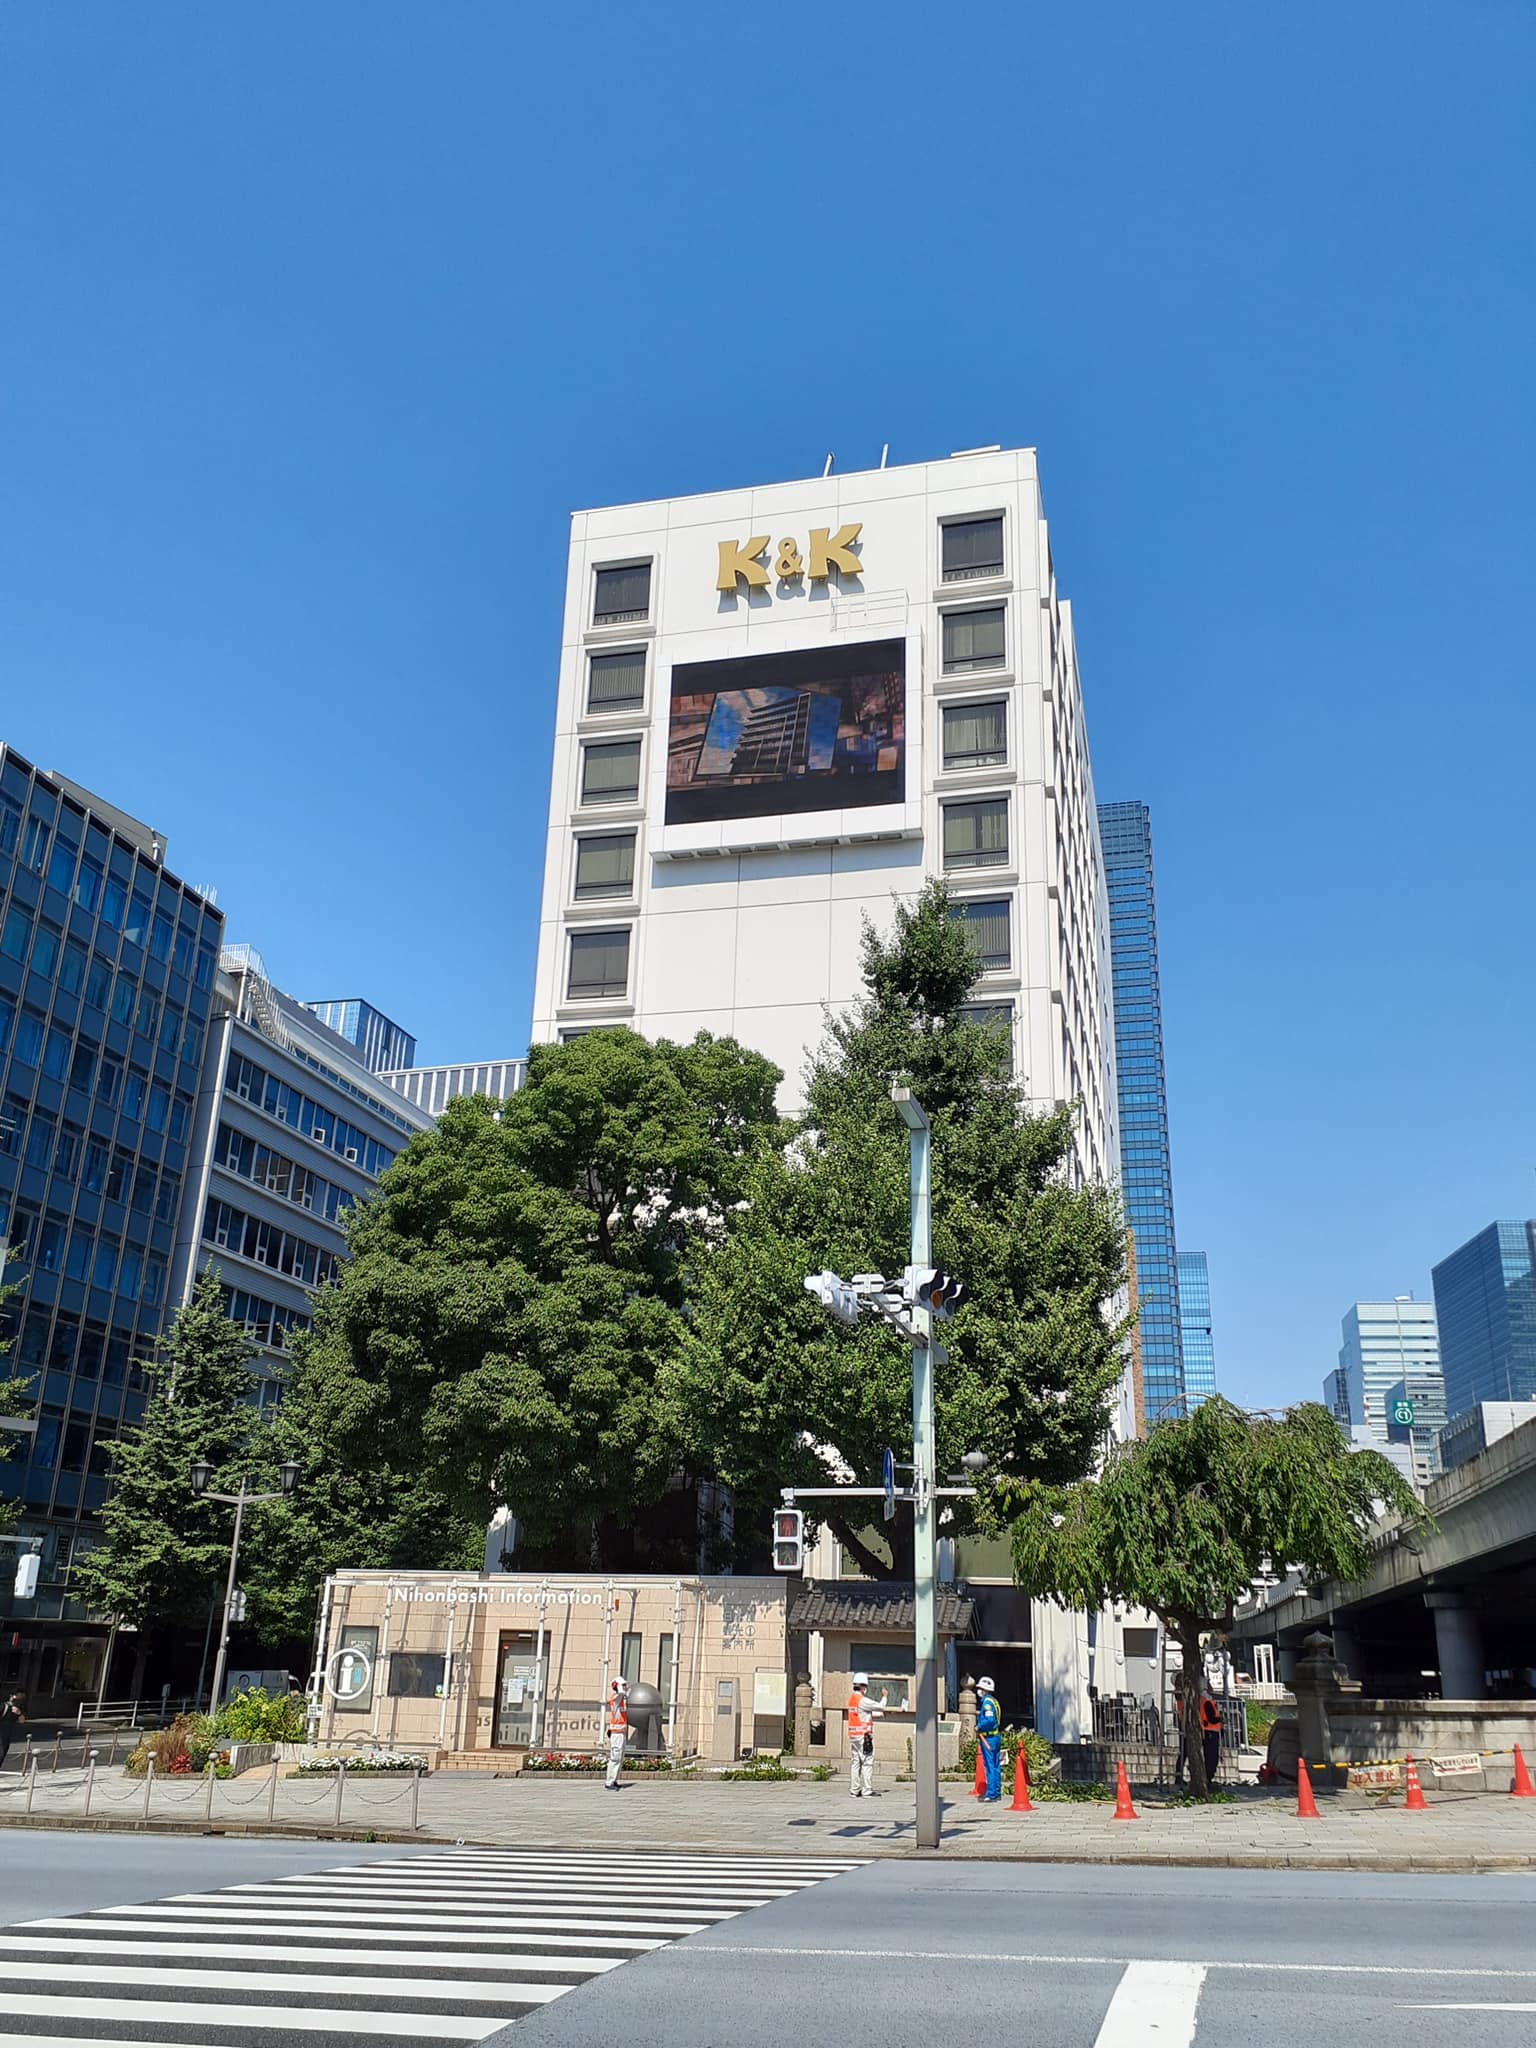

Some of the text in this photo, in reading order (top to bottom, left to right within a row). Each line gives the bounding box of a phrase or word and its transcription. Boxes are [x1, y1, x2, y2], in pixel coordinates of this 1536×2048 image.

[716, 523, 863, 591] K&K
[394, 1587, 602, 1605] Nihonbashi Information
